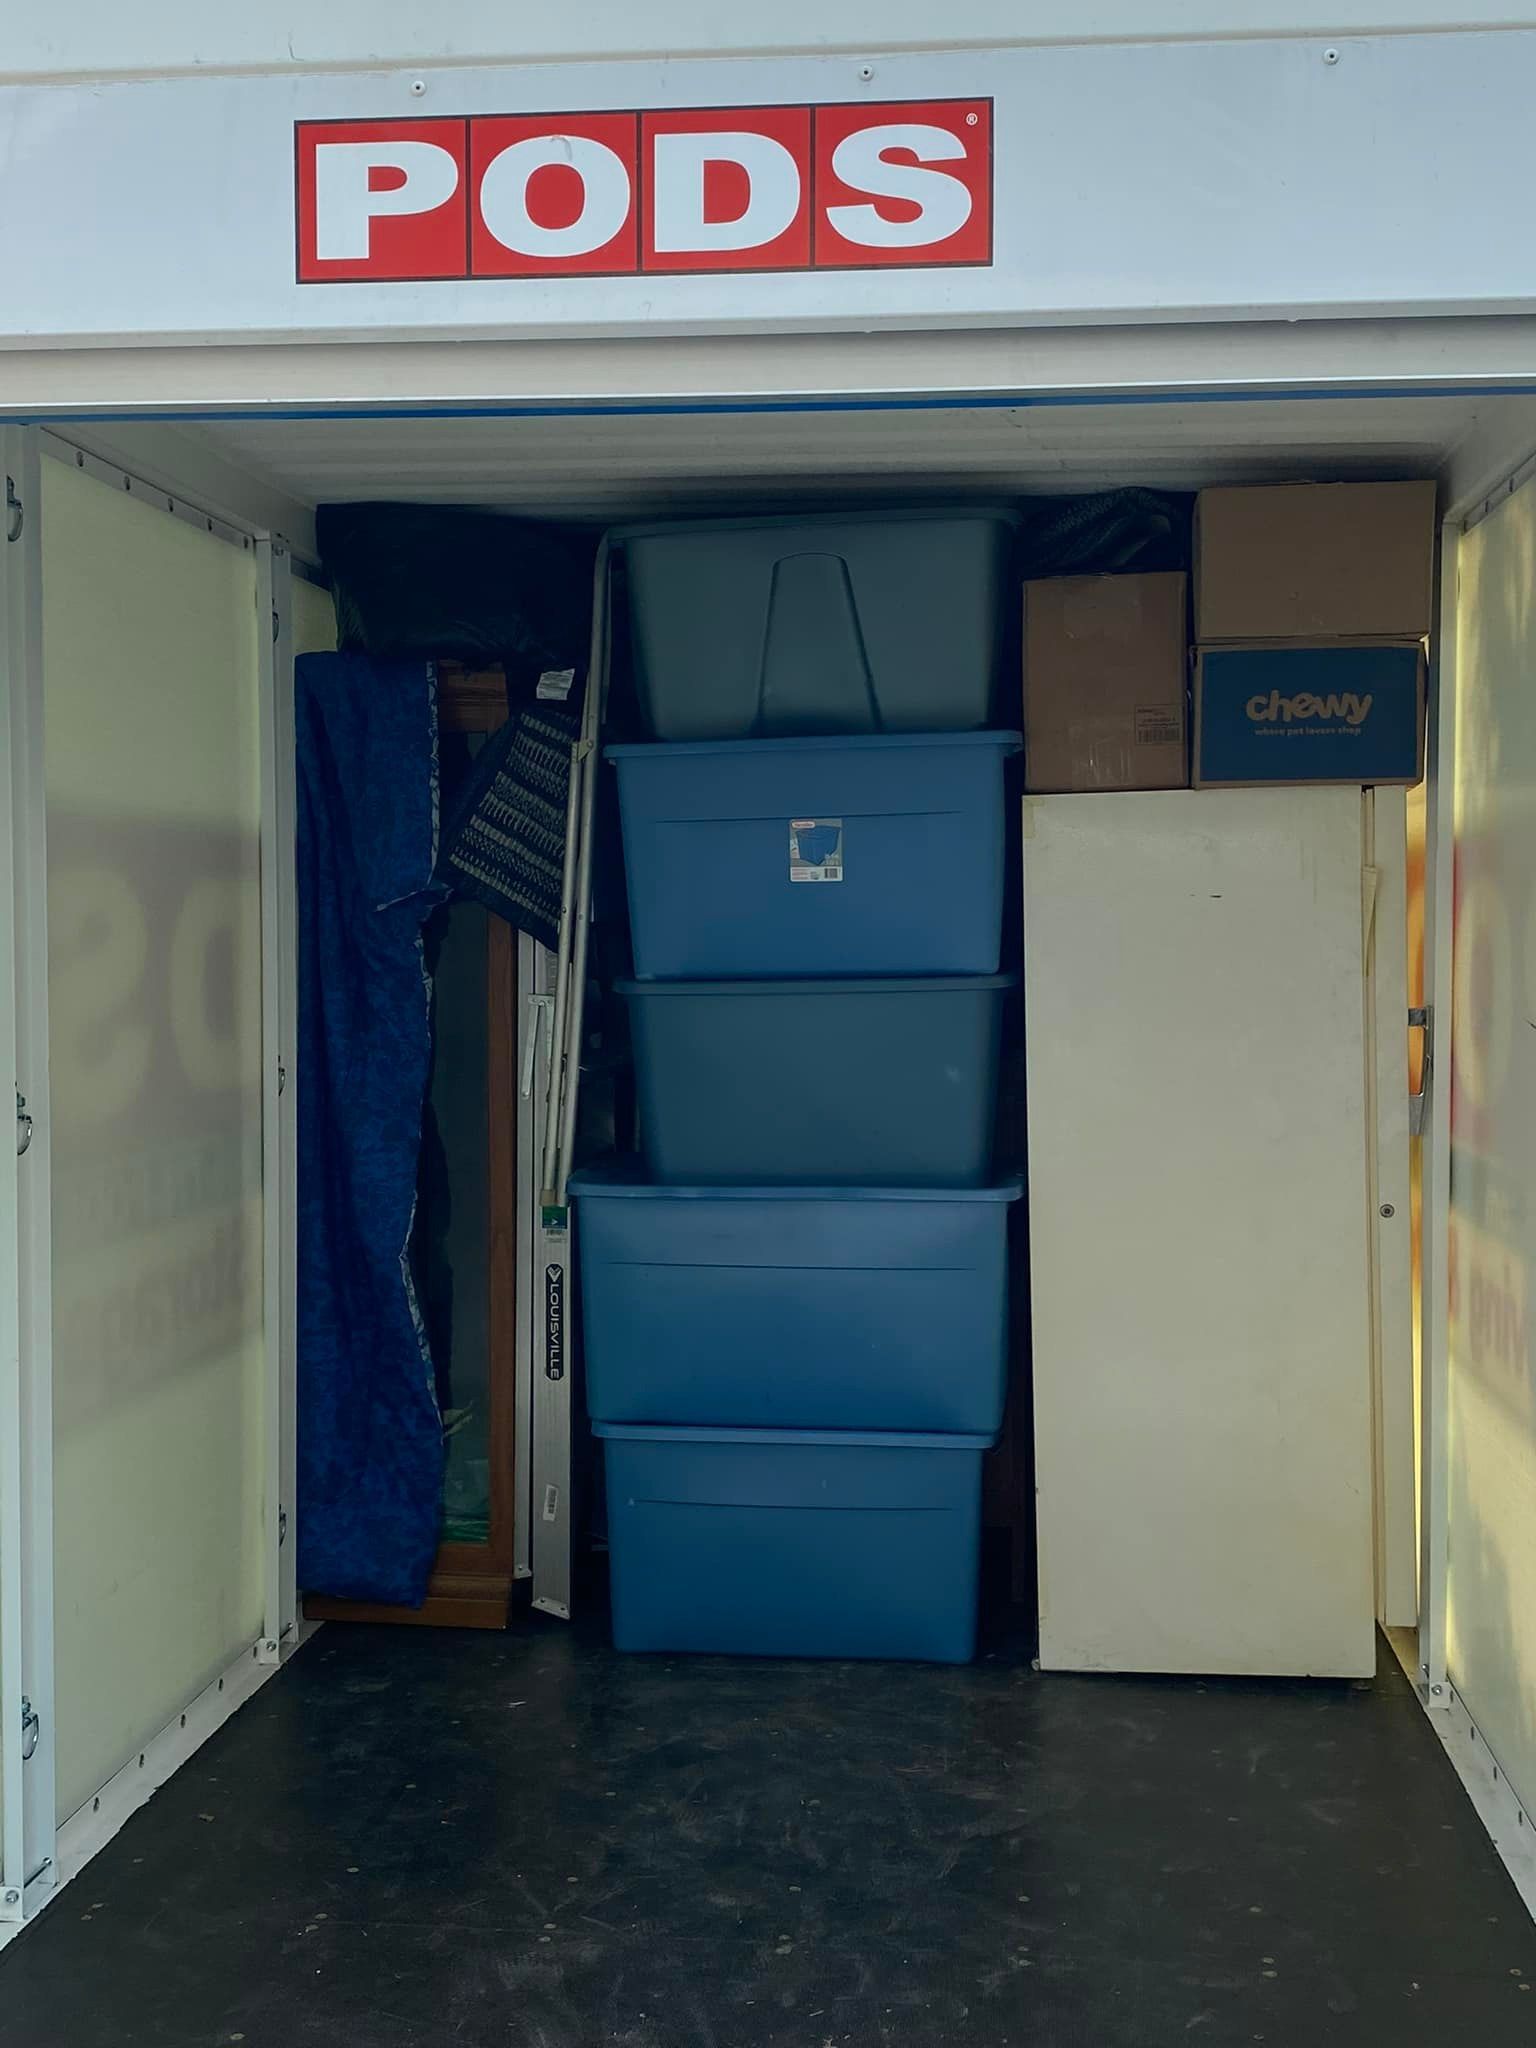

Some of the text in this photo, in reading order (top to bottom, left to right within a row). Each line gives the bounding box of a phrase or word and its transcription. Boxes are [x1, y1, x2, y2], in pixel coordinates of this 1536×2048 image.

[316, 124, 973, 260] PODS
[1246, 689, 1372, 725] chewy
[549, 1283, 561, 1380] LOUISVILLE
